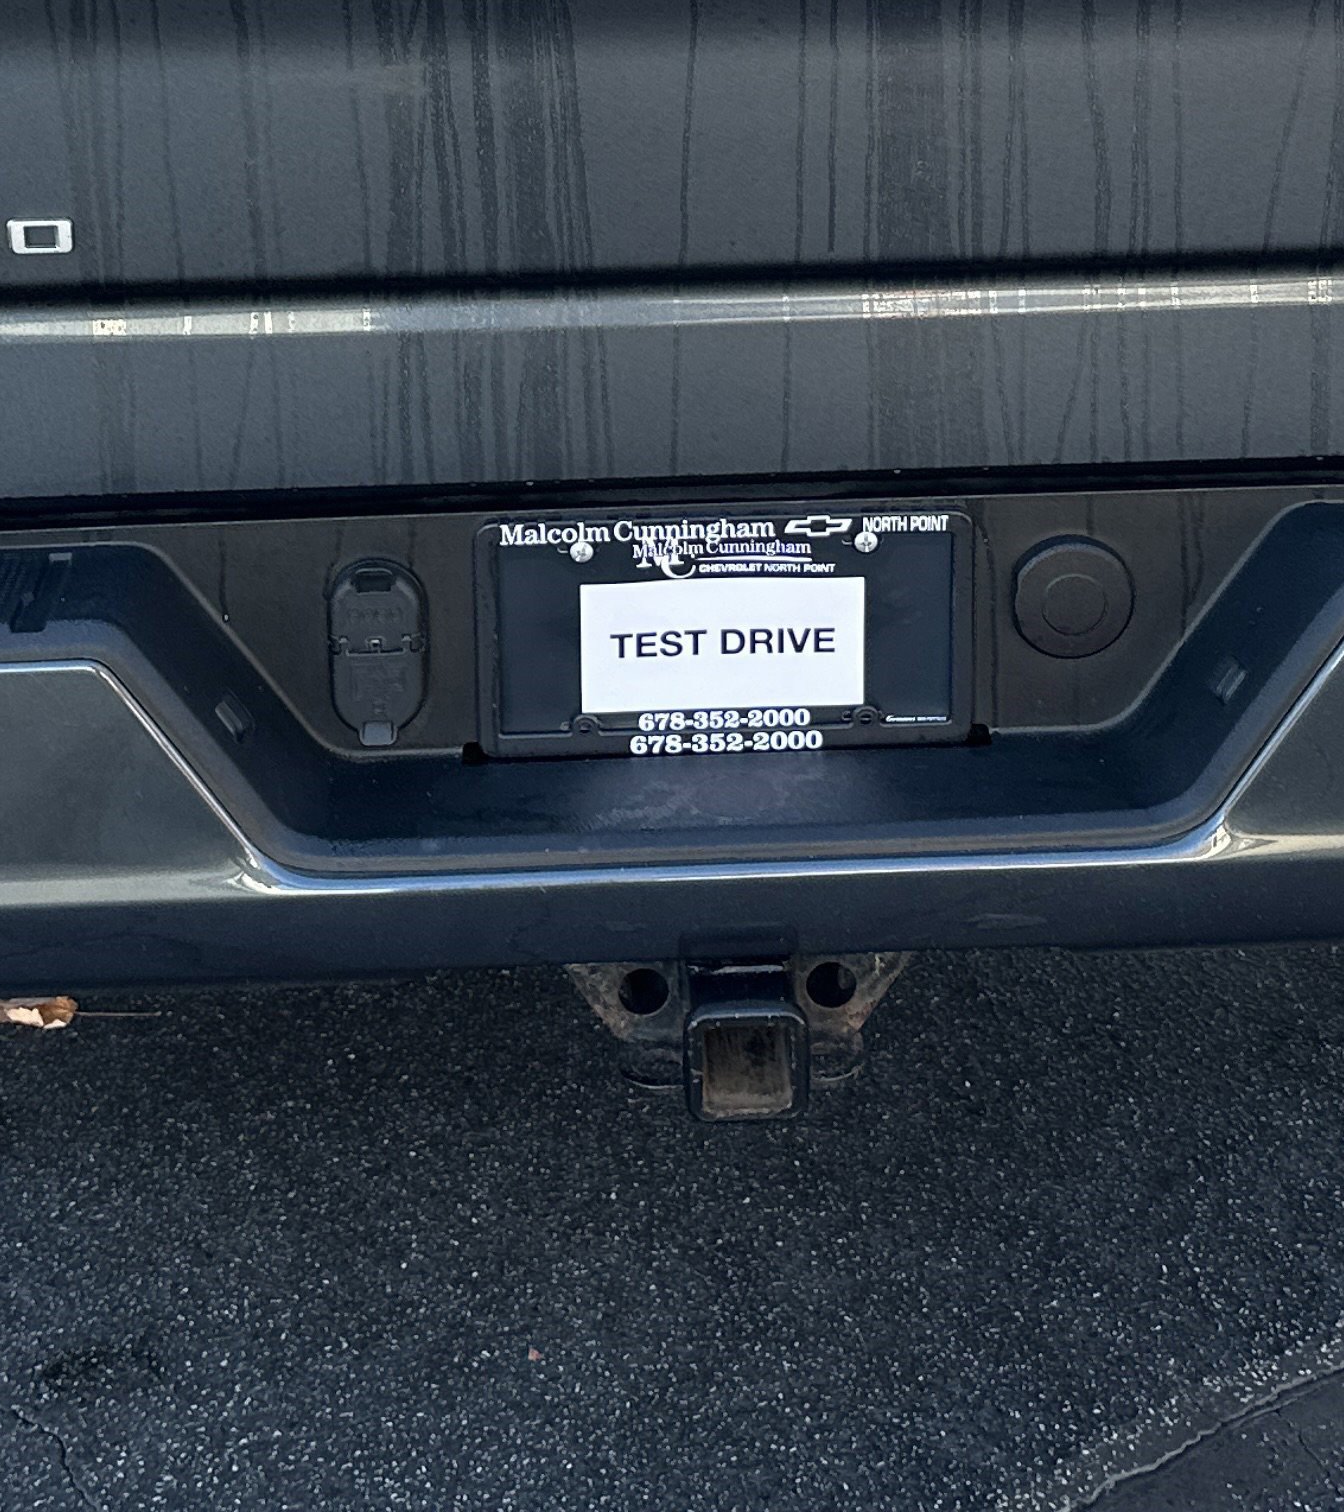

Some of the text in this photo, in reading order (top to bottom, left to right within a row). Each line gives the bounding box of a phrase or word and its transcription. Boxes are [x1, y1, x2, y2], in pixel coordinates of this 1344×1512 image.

[499, 514, 949, 546] Malcolm Cunningham NORTH POINT
[706, 539, 812, 557] Cunningham
[698, 562, 836, 573] CHEVROLET NORTH POINT
[610, 627, 836, 658] TEST DRIVE
[638, 708, 811, 732] 678-352-2000
[629, 730, 824, 755] 678-352-2000
